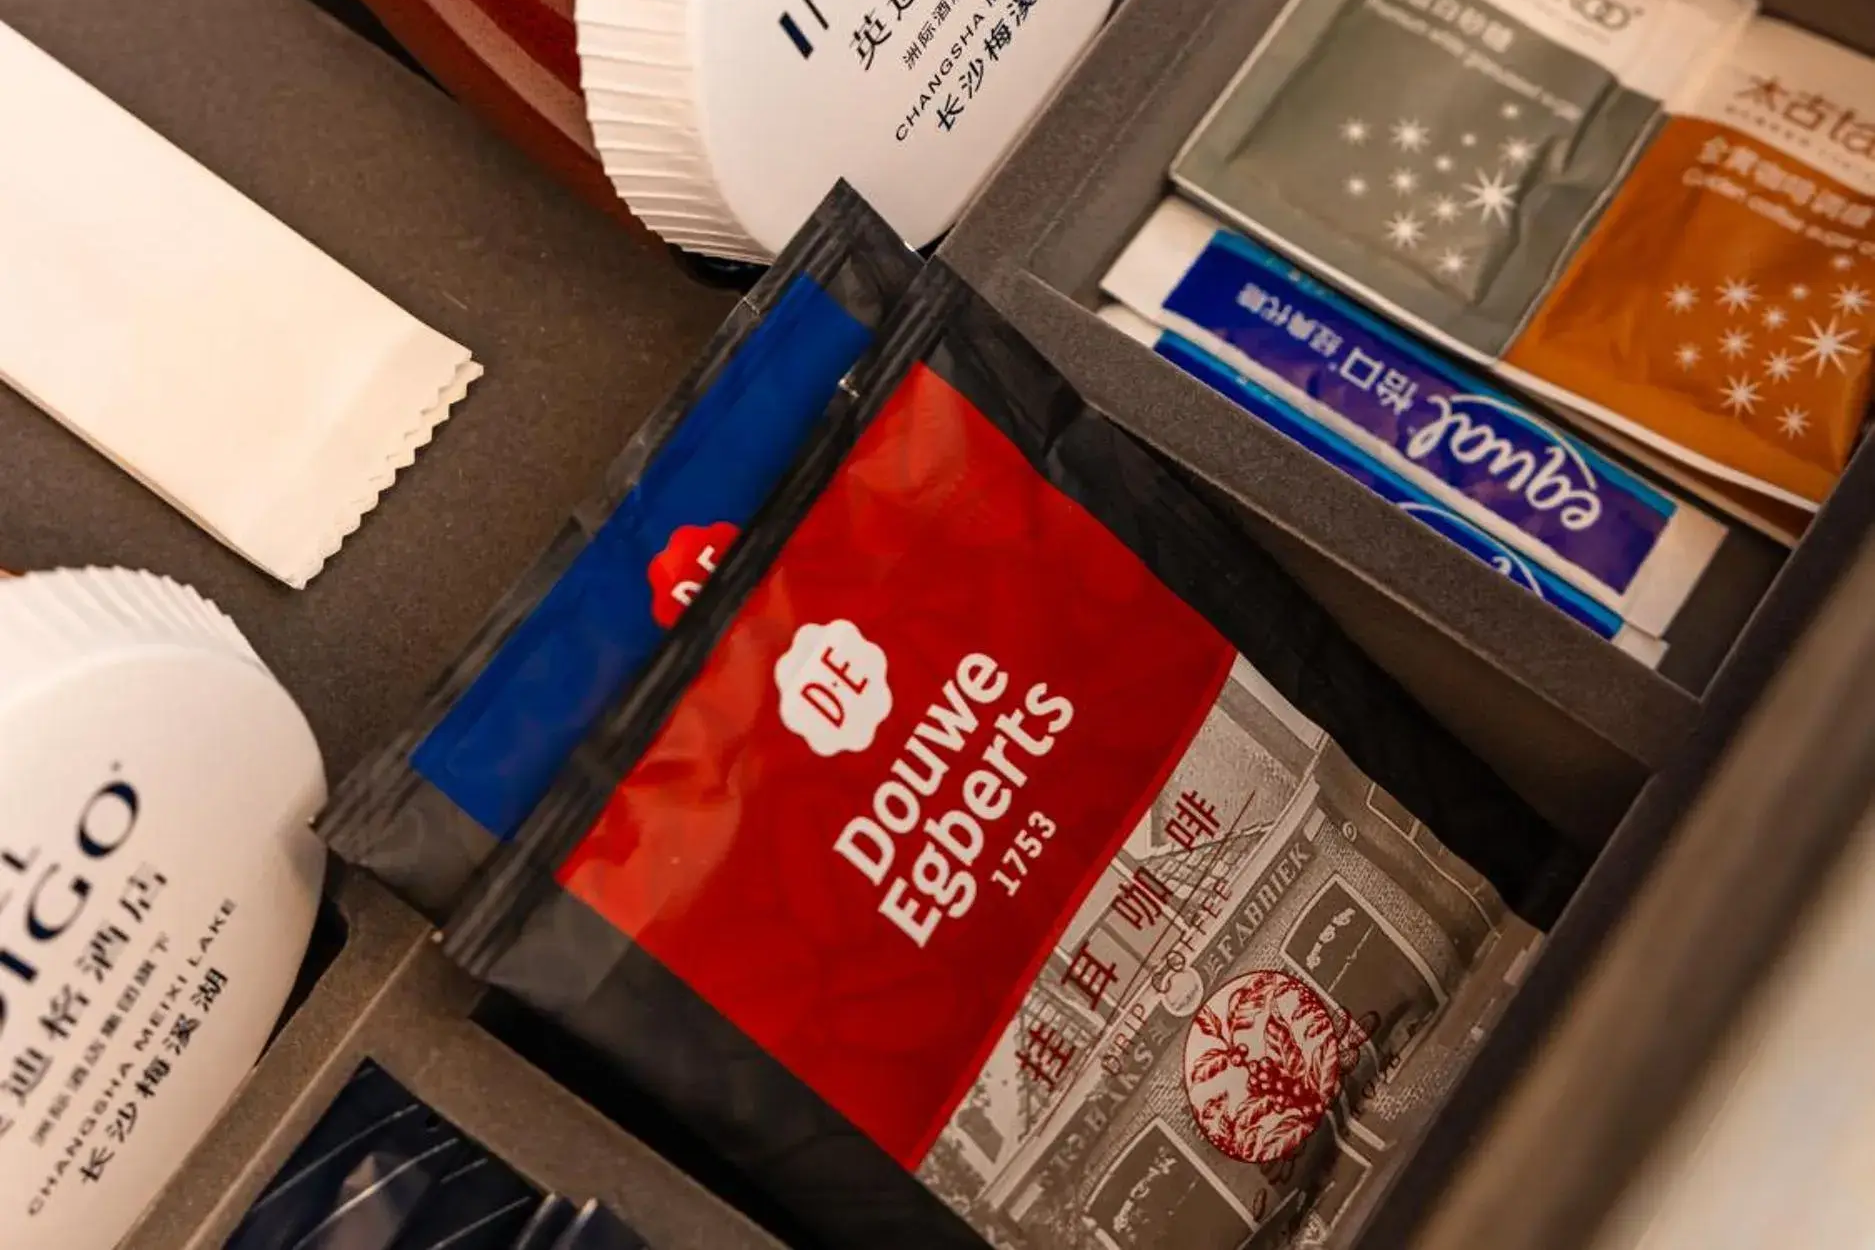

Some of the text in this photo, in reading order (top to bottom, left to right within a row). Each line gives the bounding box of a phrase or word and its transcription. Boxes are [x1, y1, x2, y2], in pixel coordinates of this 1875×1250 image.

[895, 10, 986, 141] CHANGSHA
[1339, 346, 1420, 416] 怡口
[1408, 395, 1602, 531] equal
[833, 652, 1009, 886] Douwe
[879, 682, 1074, 948] Egberts
[990, 810, 1057, 896] 1753
[0, 779, 140, 1035] IGO
[0, 862, 168, 1135] 迪格酒店
[1102, 880, 1232, 1077] DRIP COFFEE
[1216, 845, 1311, 963] FABRIEK
[27, 898, 237, 1216] CHANGSHA MEIXI LAKE
[79, 967, 229, 1184] 长沙梅溪湖
